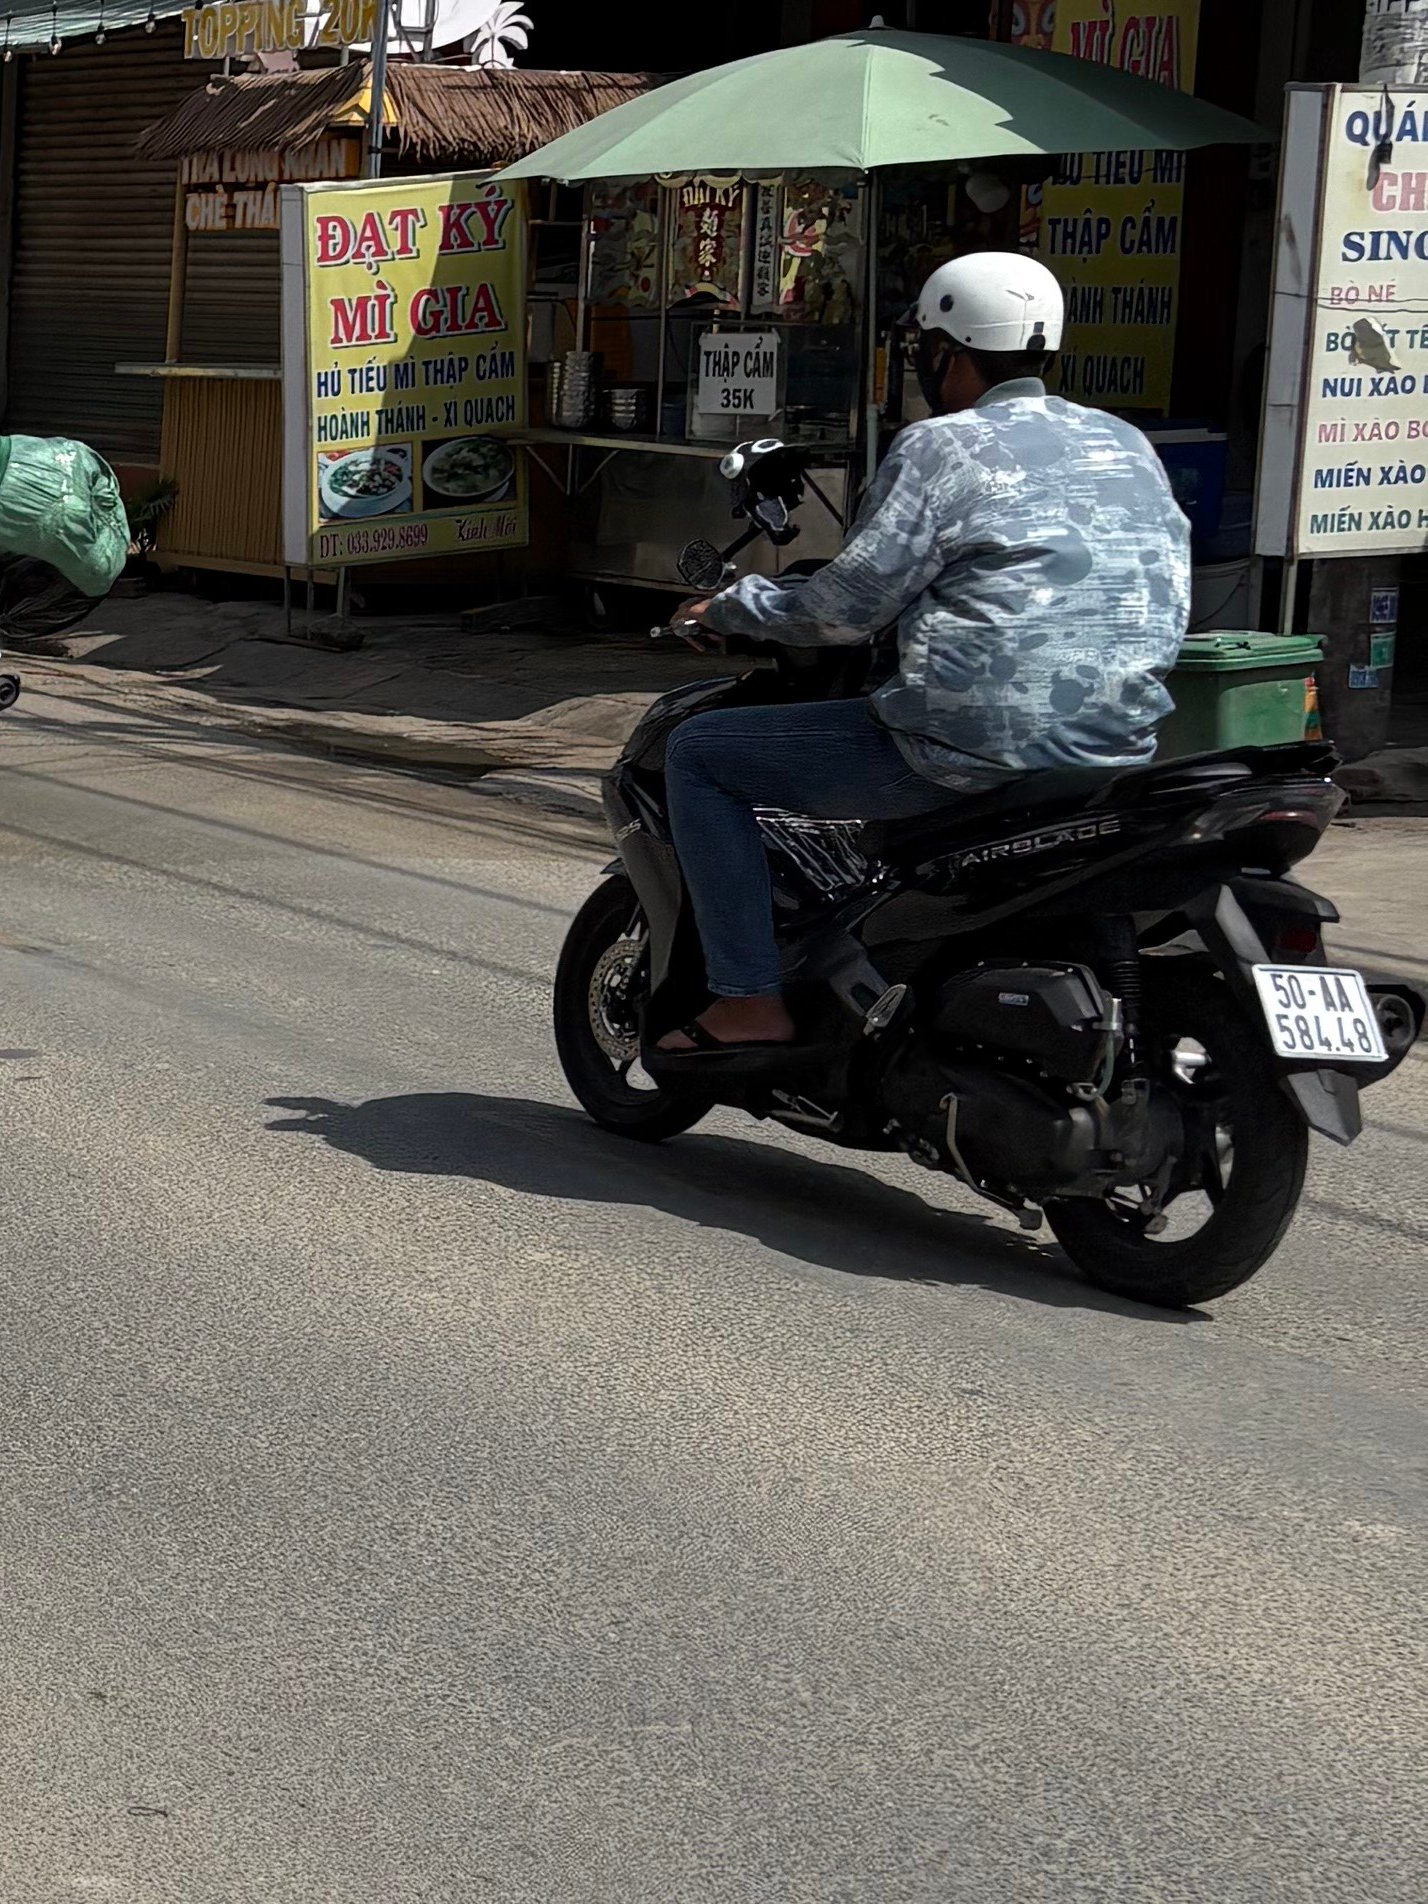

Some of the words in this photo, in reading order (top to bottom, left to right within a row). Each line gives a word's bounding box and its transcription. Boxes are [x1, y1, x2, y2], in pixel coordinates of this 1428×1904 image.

[1345, 100, 1428, 146] QUÁ
[316, 207, 428, 274] ĐẠT
[1048, 207, 1112, 263] THẬP
[329, 279, 395, 347] MÌ
[409, 282, 507, 337] GIA
[317, 362, 342, 398] HỦ
[349, 355, 388, 395] TIẾU
[394, 356, 416, 391] MÌ
[422, 350, 468, 390] THẬP
[704, 342, 741, 383] THẬP
[721, 388, 755, 409] 35K
[1322, 377, 1363, 398] NUI
[317, 408, 371, 443] HOÀNH
[376, 400, 427, 436] THÁNH
[1314, 460, 1372, 489] MIẾN
[1378, 459, 1426, 486] XÀO
[1310, 505, 1363, 534] MIẾN
[1368, 504, 1412, 532] XÀO
[1270, 973, 1355, 1013] 50-AA
[1275, 1014, 1373, 1053] 584.48
